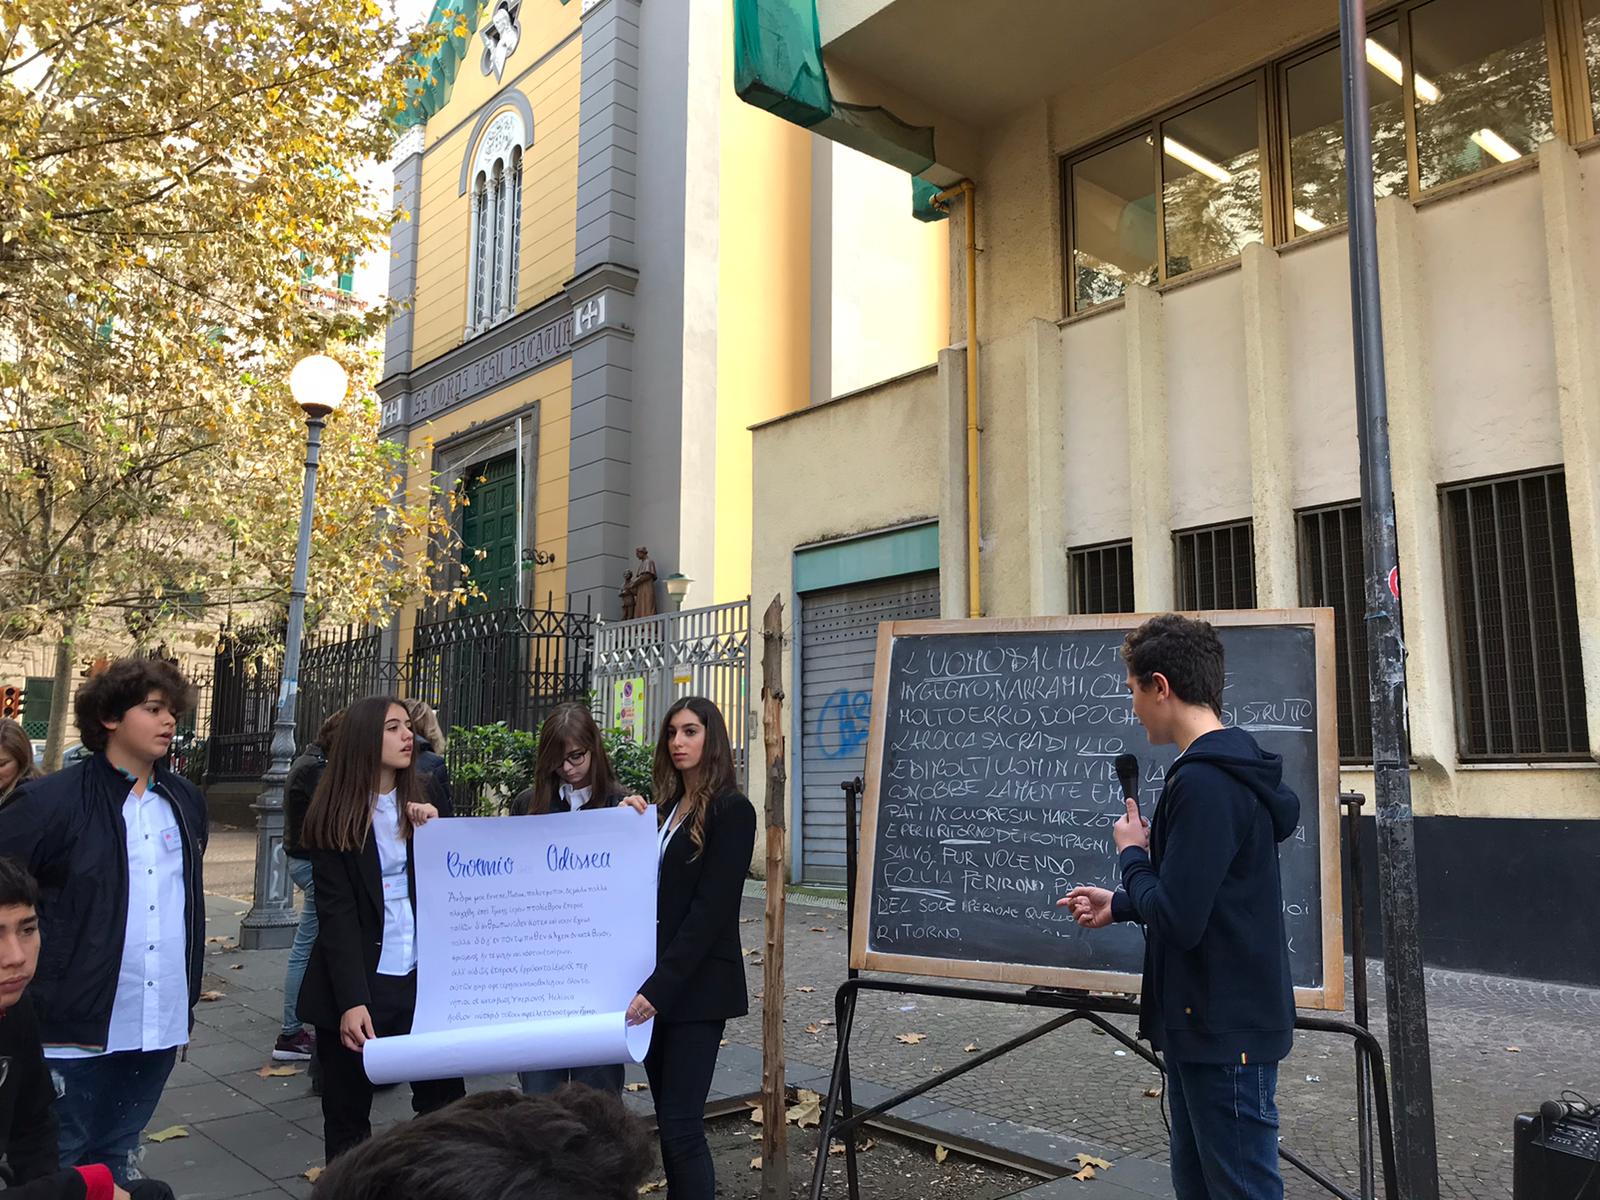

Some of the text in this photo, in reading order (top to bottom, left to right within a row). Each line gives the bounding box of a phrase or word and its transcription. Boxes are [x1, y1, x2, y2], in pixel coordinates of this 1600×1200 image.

[900, 706, 966, 727] MOLTO
[546, 843, 612, 873] Odissea
[984, 849, 1076, 876] VOLENDO
